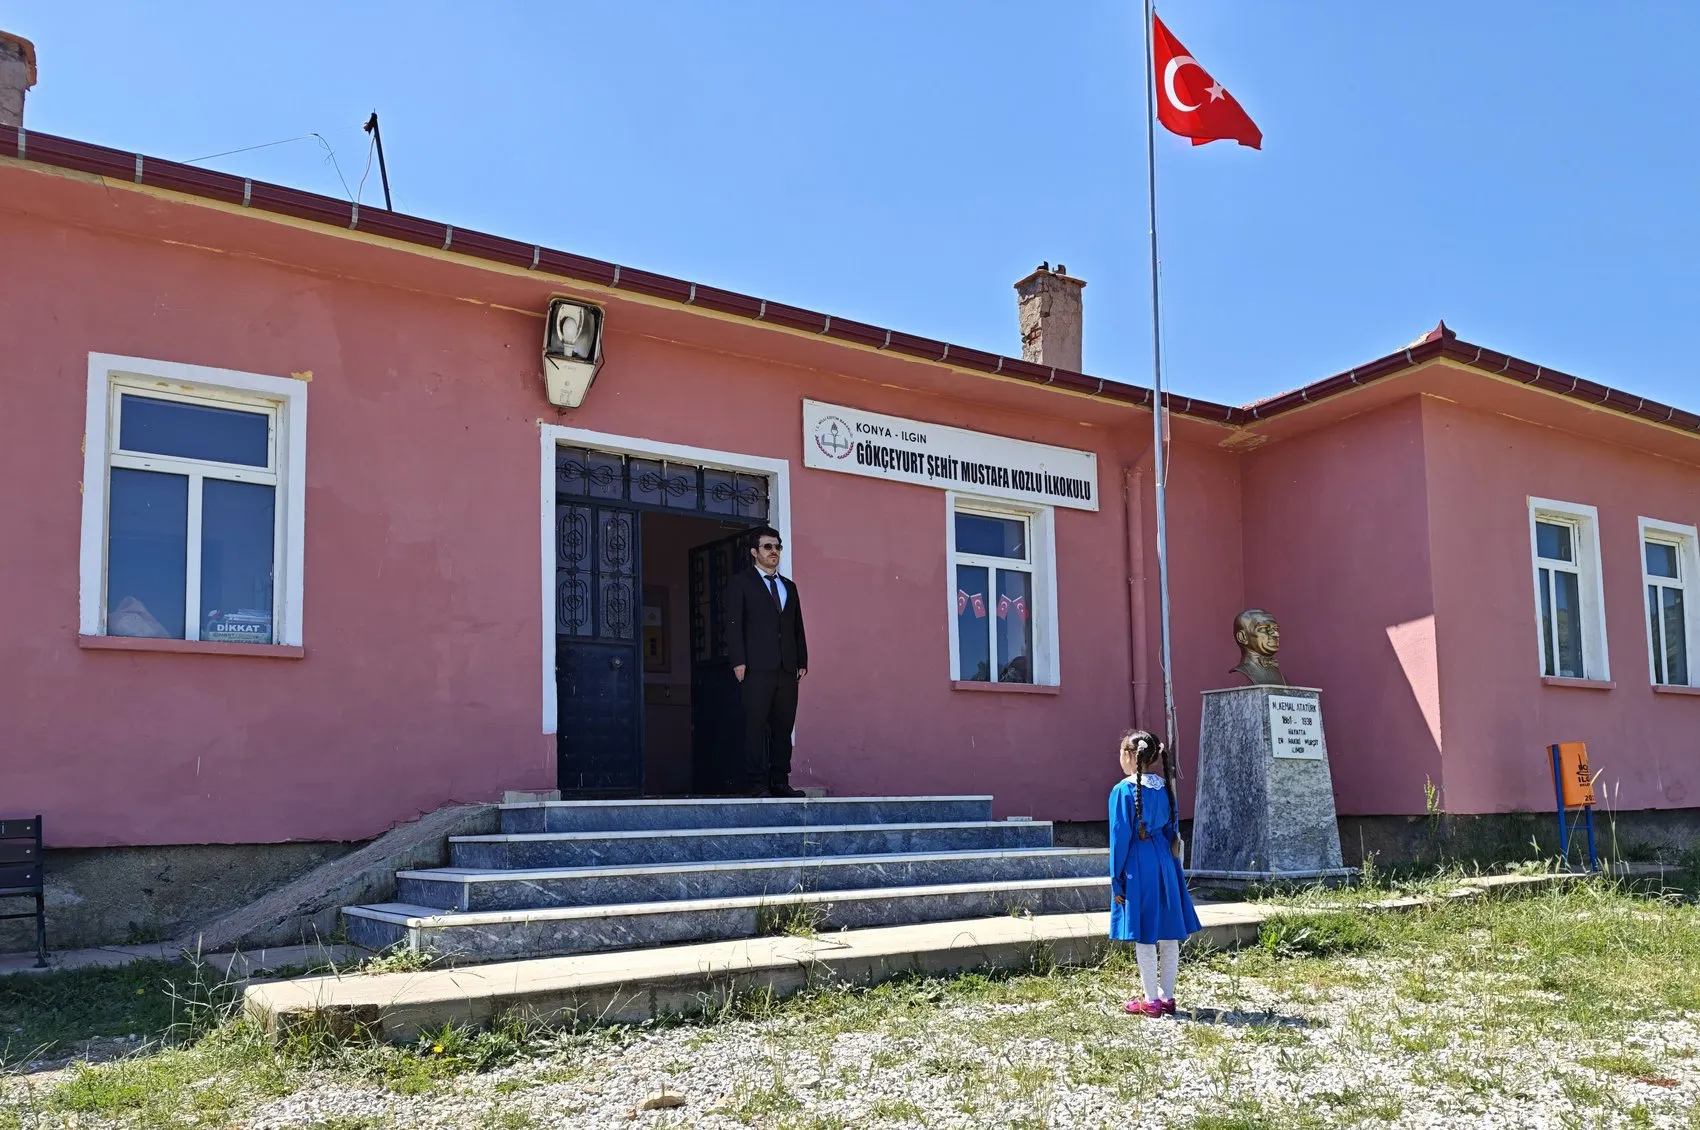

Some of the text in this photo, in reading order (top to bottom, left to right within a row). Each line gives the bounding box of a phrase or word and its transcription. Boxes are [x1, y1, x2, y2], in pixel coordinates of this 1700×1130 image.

[856, 422, 892, 438] KONYA
[901, 430, 927, 444] ILGIN
[856, 440, 1091, 501] GÖKÇEYURT ŞEHİT MUSTAFA KOZLU İLKOKULU
[216, 623, 260, 632] DİKKAT
[1296, 703, 1317, 712] ATATÜRK
[1301, 717, 1312, 726] 1938
